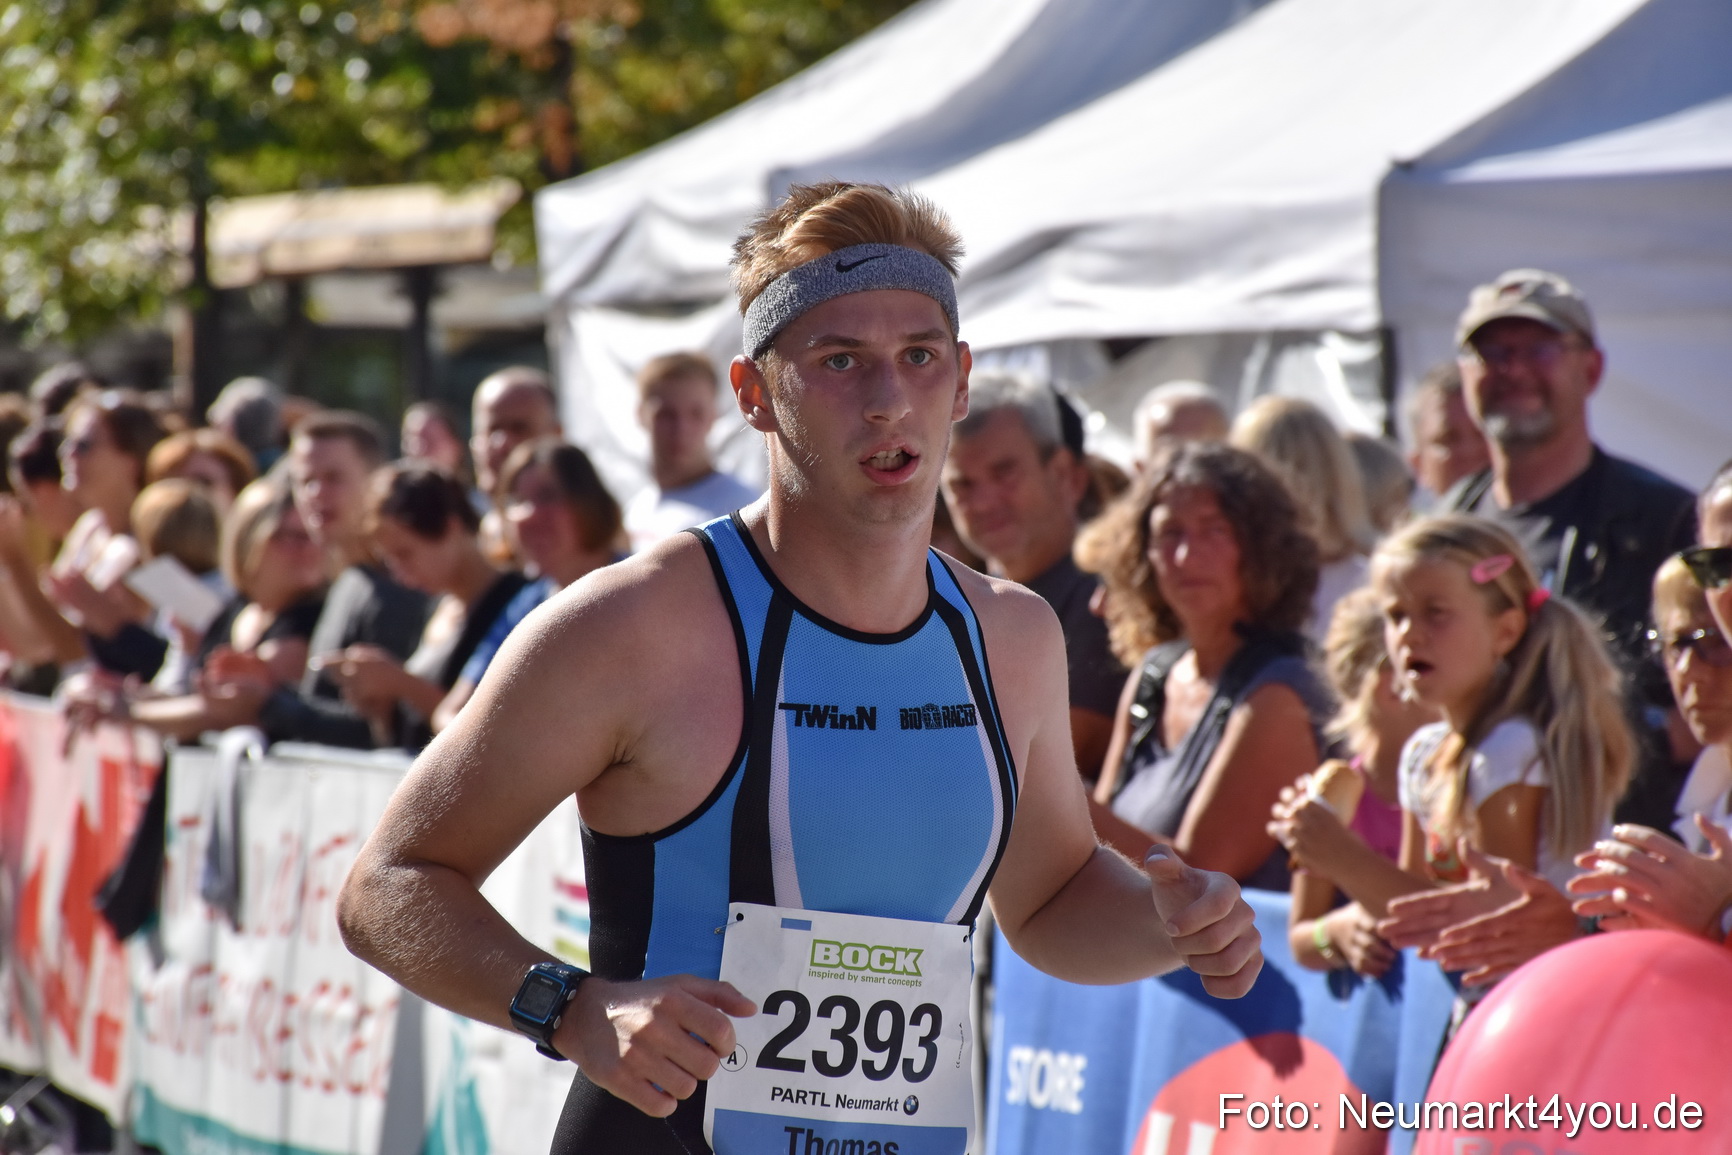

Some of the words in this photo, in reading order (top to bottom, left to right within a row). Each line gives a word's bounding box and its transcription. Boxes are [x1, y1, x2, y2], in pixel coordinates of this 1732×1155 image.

[810, 939, 924, 977] BOCK
[808, 969, 845, 980] inspired
[848, 973, 858, 983] by
[861, 975, 885, 984] smart
[888, 978, 922, 988] concepts
[756, 990, 943, 1083] 2393
[726, 1050, 738, 1066] A
[1006, 1046, 1087, 1115] STORE
[770, 1087, 831, 1108] PARTL
[835, 1095, 900, 1112] Neumarkt
